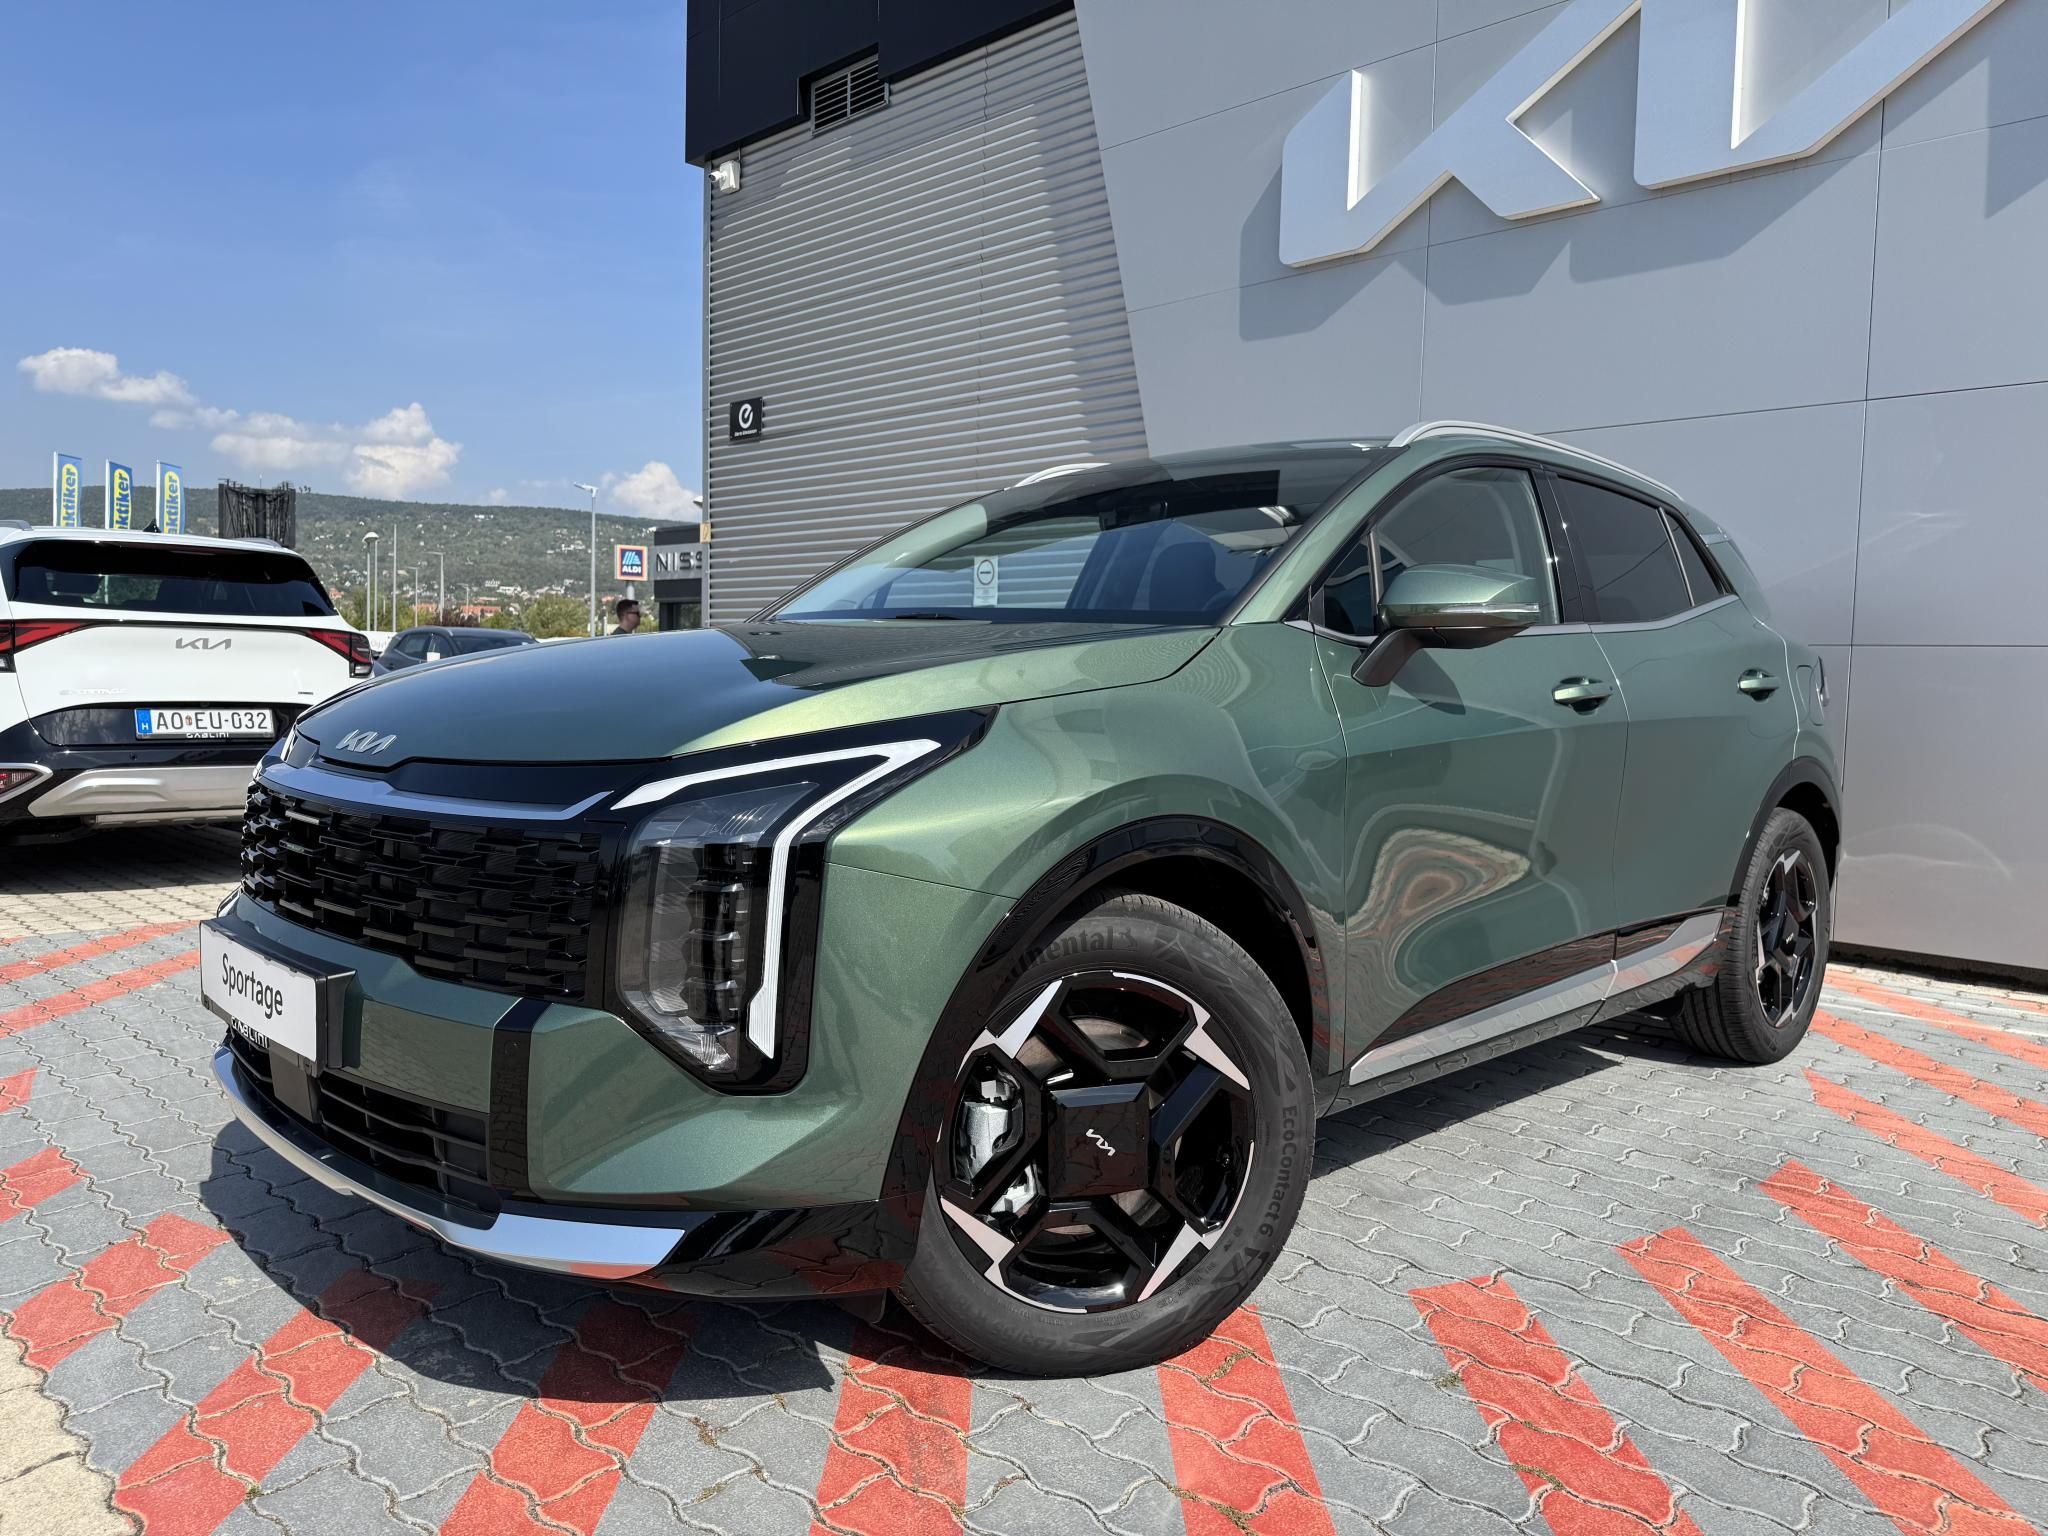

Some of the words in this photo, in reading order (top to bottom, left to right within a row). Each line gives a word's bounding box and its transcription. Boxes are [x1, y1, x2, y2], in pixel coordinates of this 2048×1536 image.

[115, 472, 129, 528] ktiker
[622, 565, 642, 574] ALDI
[141, 722, 149, 730] H
[156, 711, 184, 731] AO
[195, 711, 268, 730] EU-032
[222, 952, 284, 1020] Sportage
[1265, 1104, 1298, 1222] EcoContact
[1258, 1222, 1275, 1238] 6
